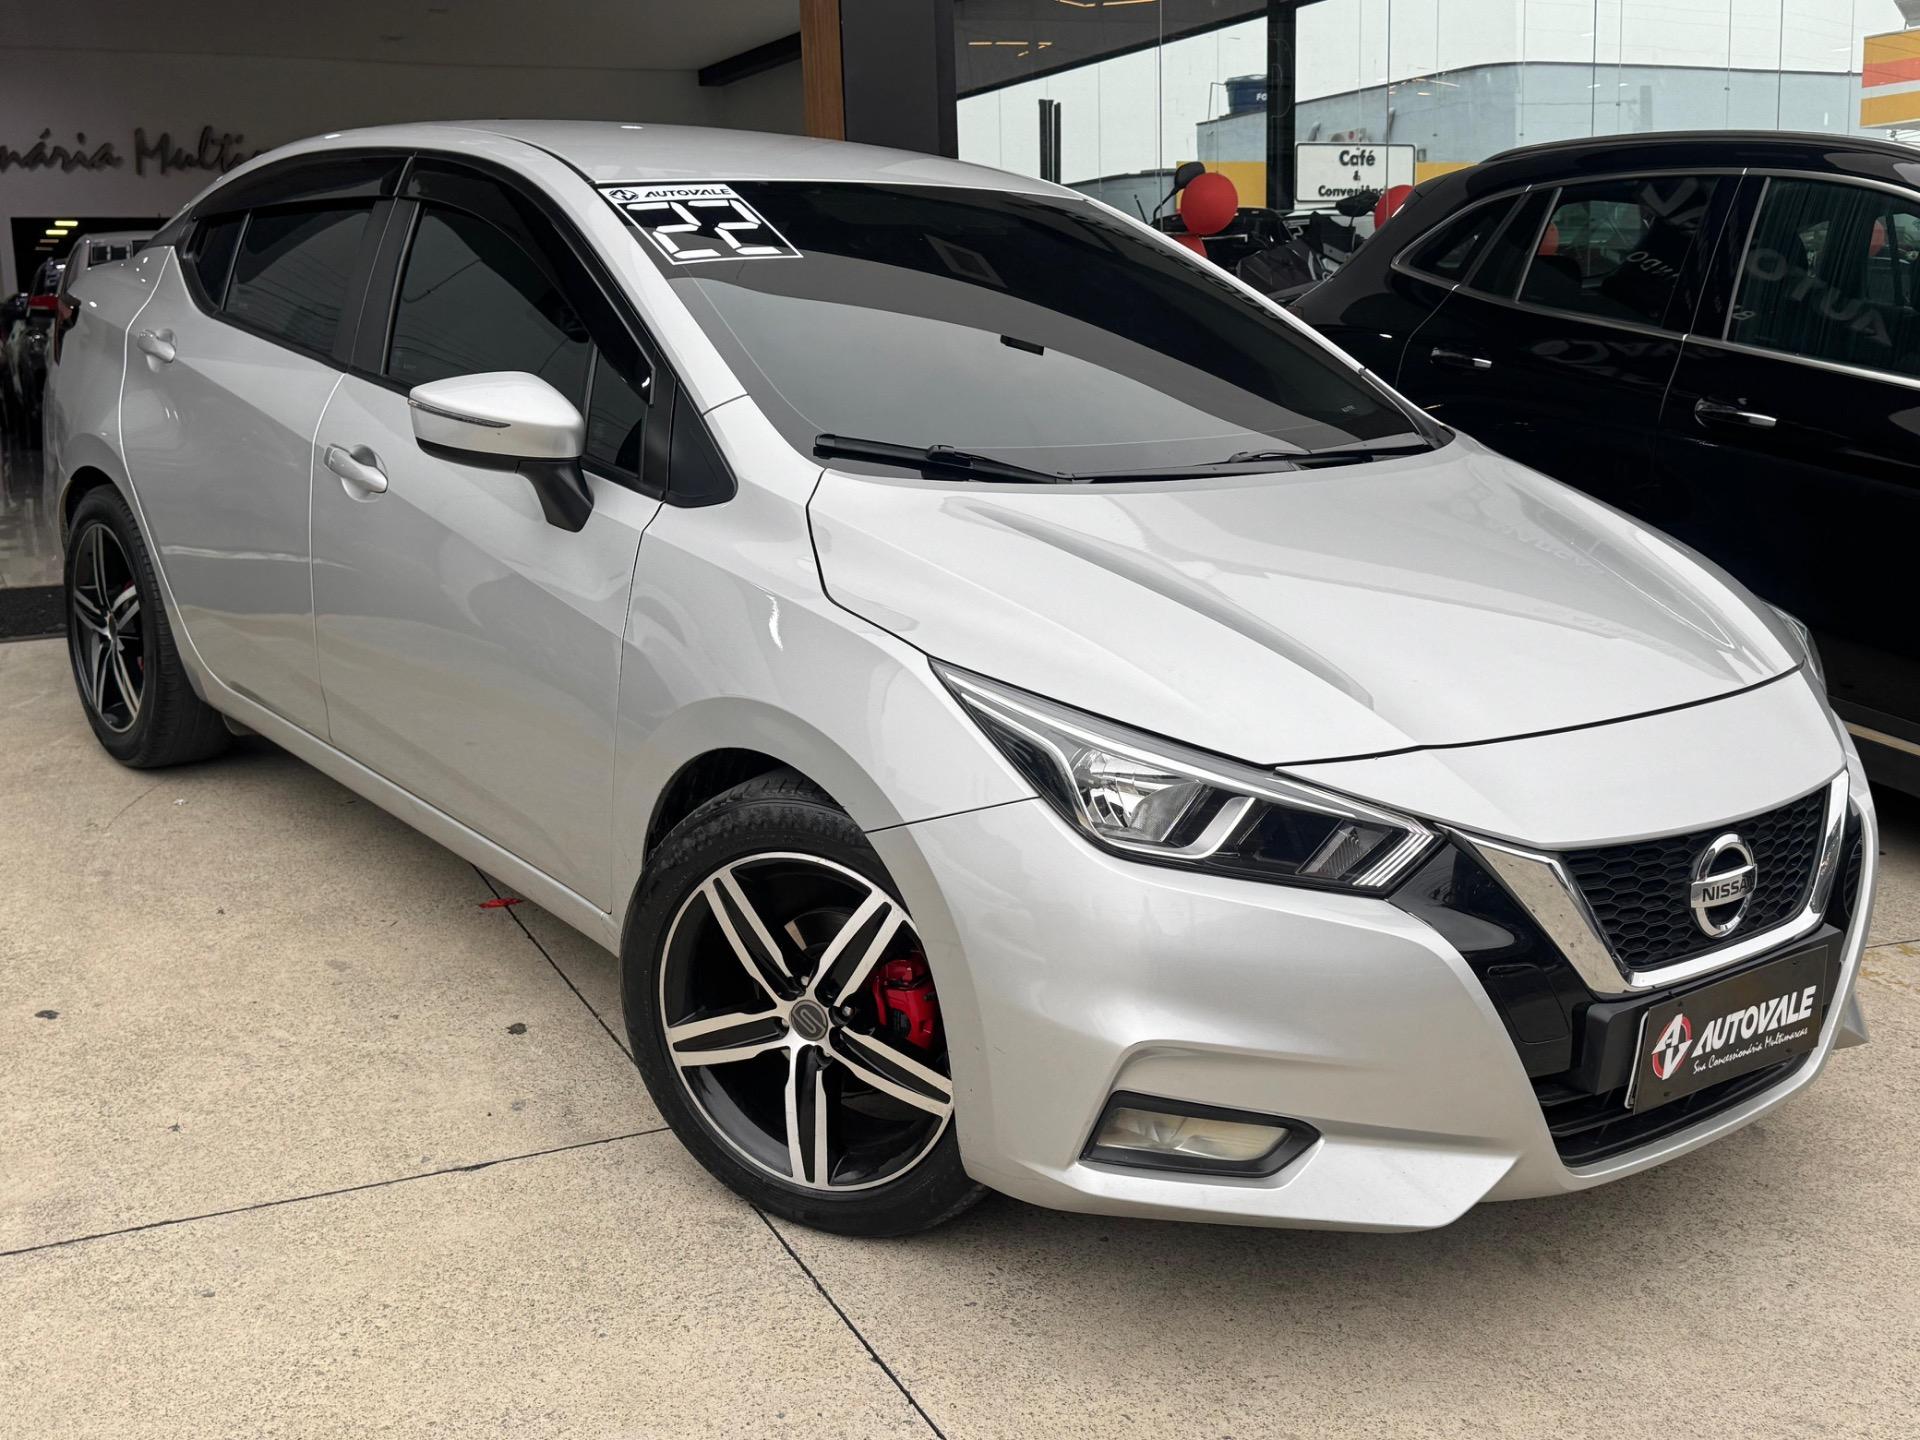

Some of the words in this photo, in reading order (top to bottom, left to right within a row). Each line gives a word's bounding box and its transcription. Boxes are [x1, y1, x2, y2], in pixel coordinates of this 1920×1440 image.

[134, 124, 269, 176] Multi
[1339, 149, 1376, 166] Café
[644, 187, 732, 199] AUTOVALE
[1353, 170, 1361, 181] &
[626, 199, 783, 260] 22
[1702, 874, 1755, 903] NISSAN
[1690, 984, 1817, 1059] AUTOVALE
[1692, 1059, 1707, 1075] Sua
[1708, 1041, 1763, 1070] Concessionária
[1764, 1026, 1809, 1049] Multimarcas
